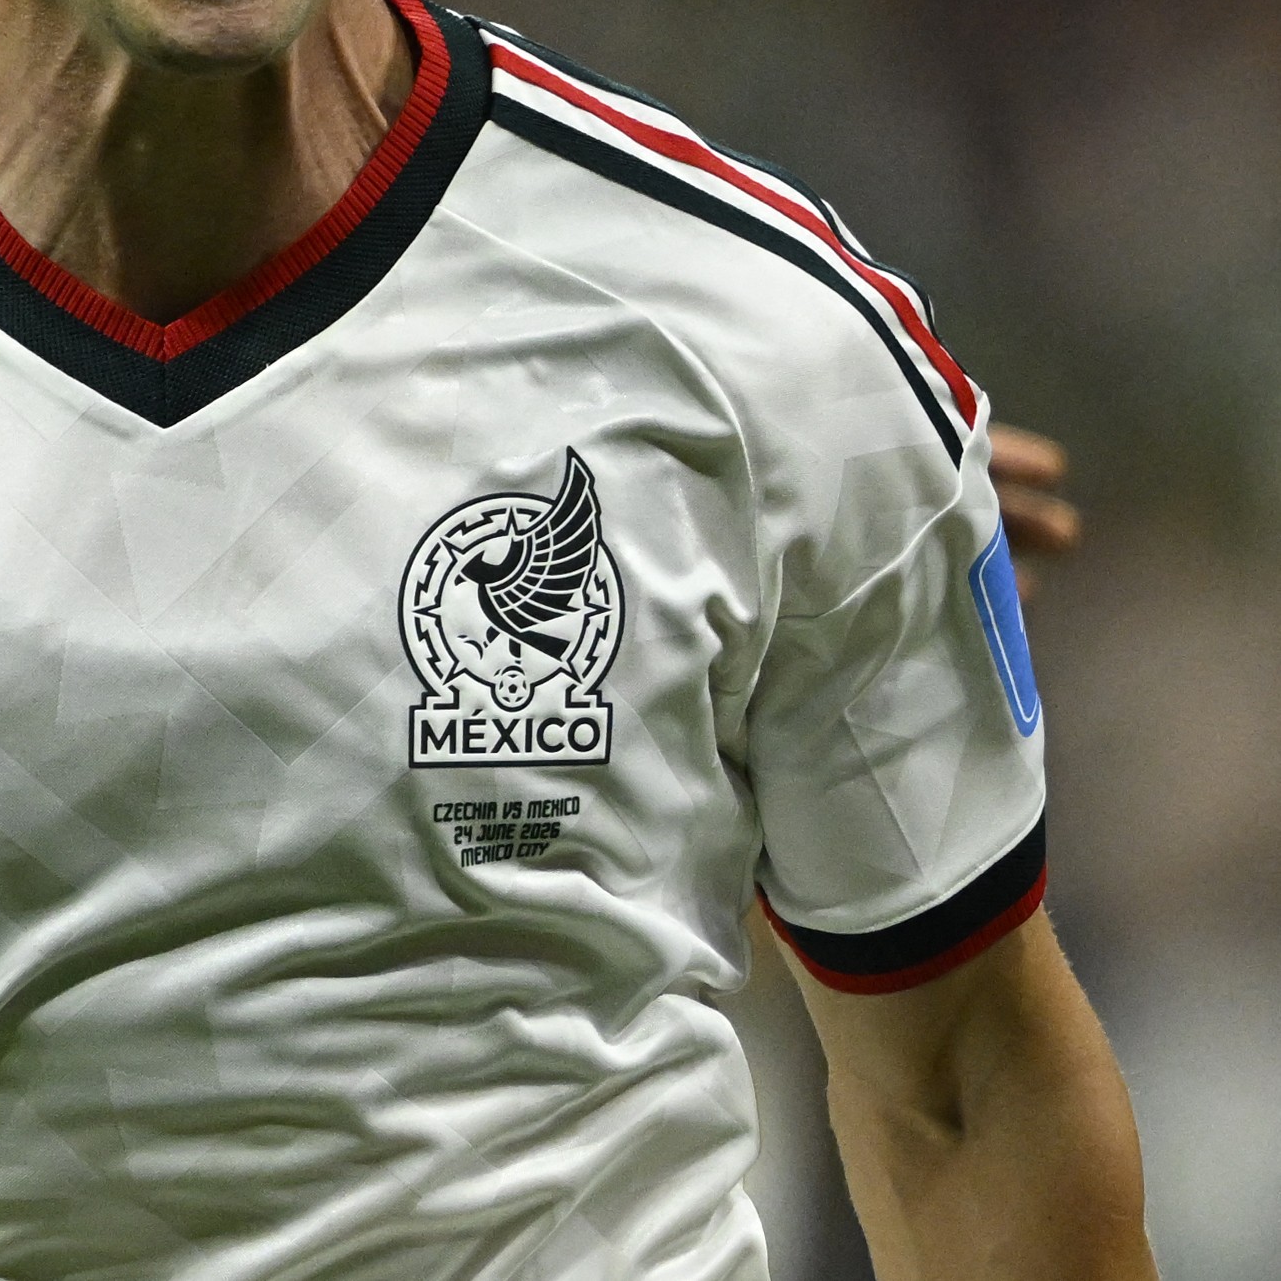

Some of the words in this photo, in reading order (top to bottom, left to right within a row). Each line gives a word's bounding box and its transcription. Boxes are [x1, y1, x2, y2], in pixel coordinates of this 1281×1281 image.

[420, 708, 601, 754] MÉXICO
[434, 802, 497, 822] CZECHIA
[503, 801, 522, 819] VS
[528, 796, 580, 818] MEXICO
[454, 825, 473, 844] 24
[476, 824, 516, 841] JUNE
[520, 822, 561, 839] 2026
[461, 844, 514, 867] MEXICO
[517, 842, 550, 857] CITY
